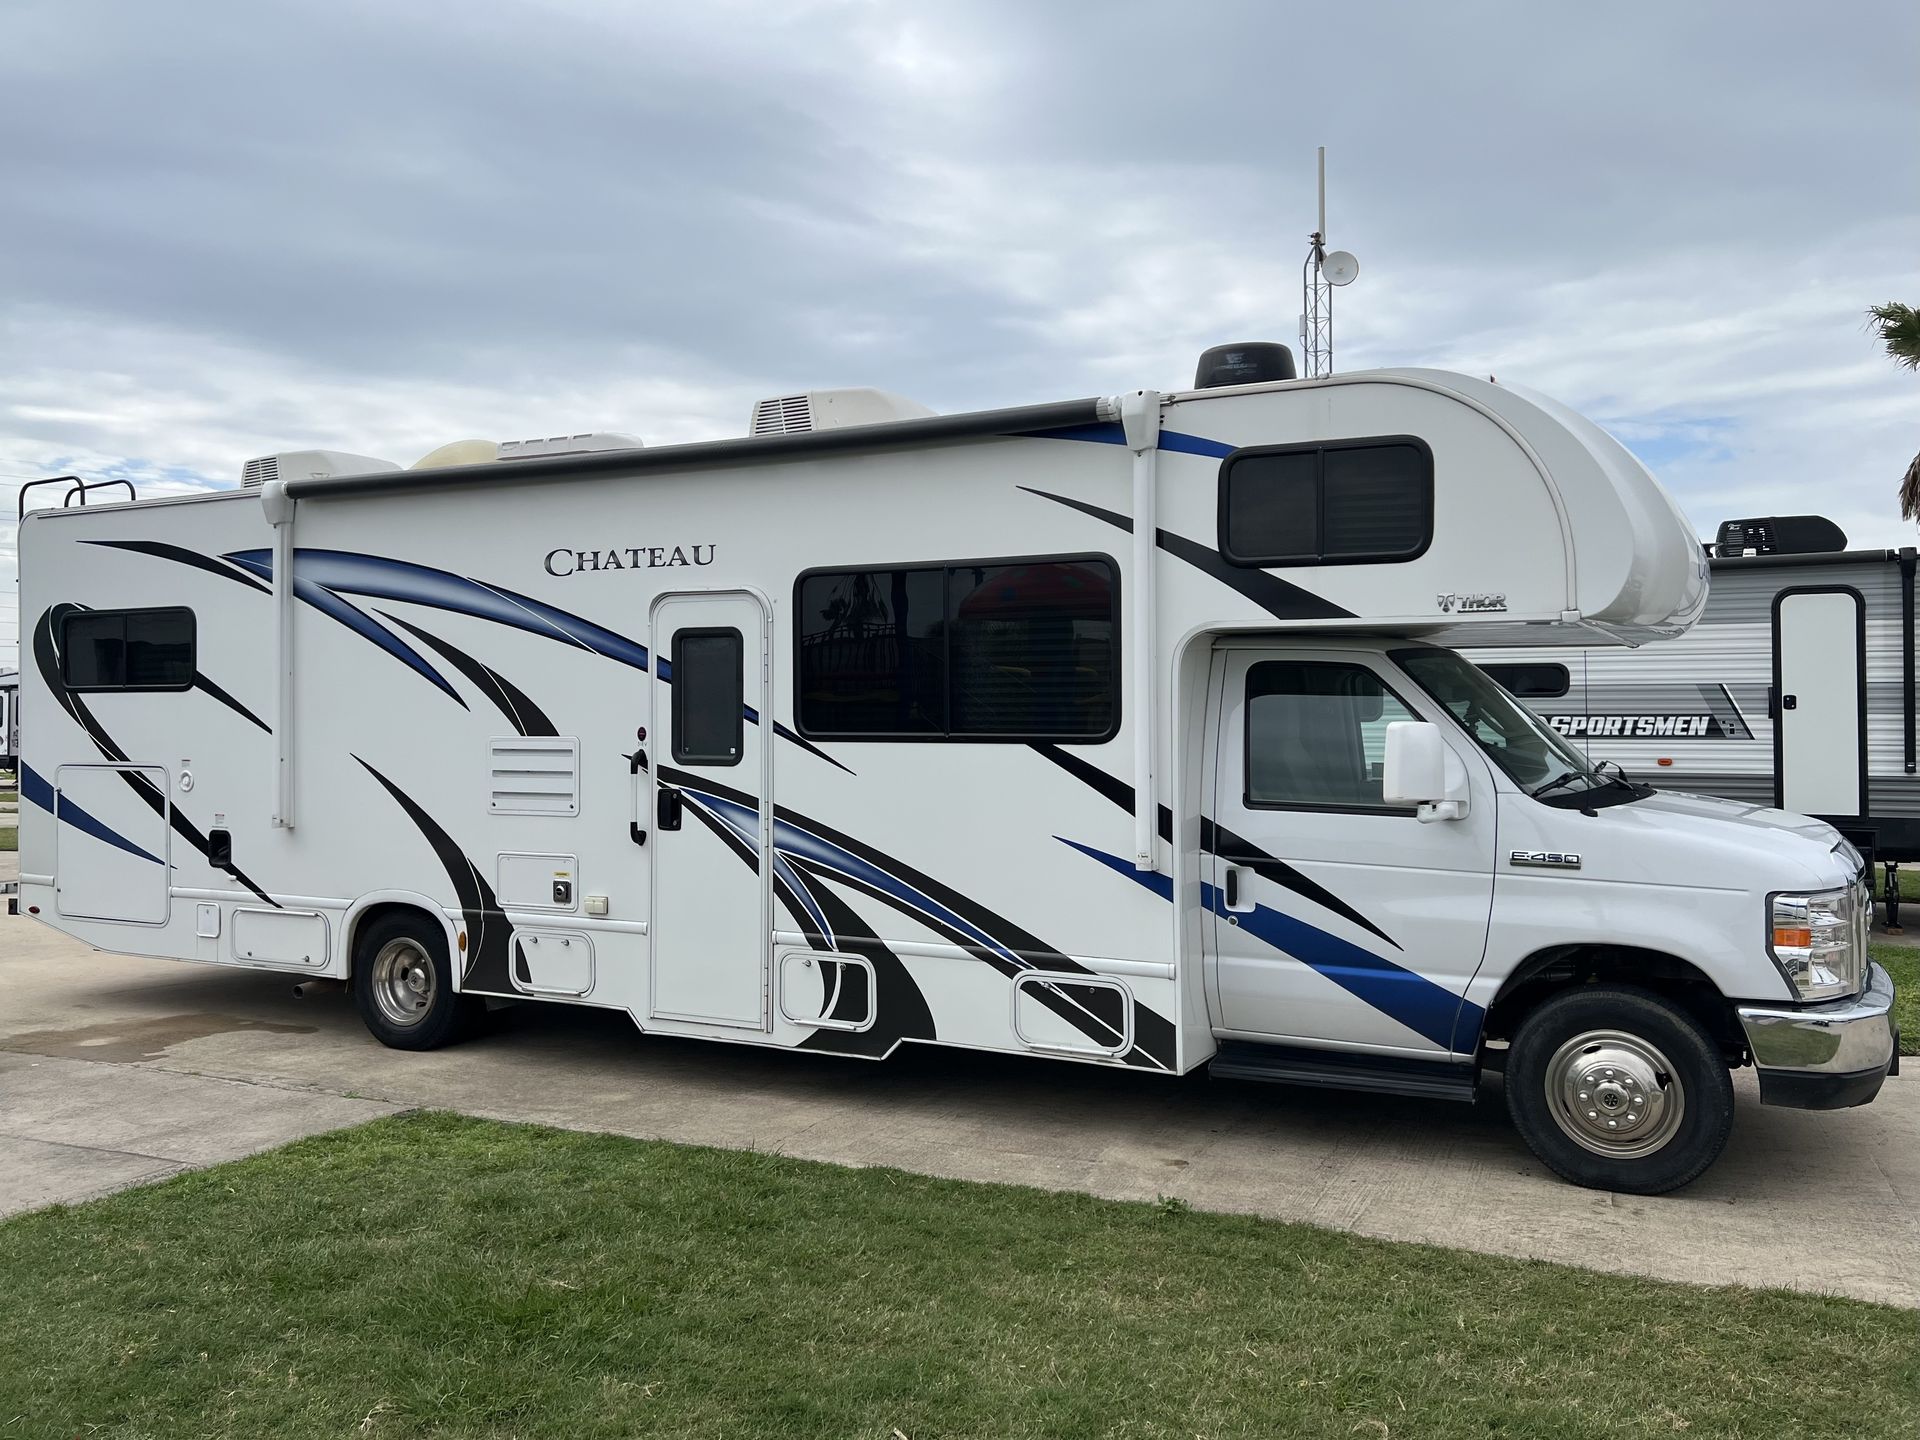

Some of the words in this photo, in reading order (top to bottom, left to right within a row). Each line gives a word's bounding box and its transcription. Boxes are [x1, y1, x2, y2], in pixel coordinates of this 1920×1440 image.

[543, 544, 717, 577] CHATEAU
[1457, 592, 1507, 610] THOR
[1550, 716, 1709, 736] SPORTSMEN
